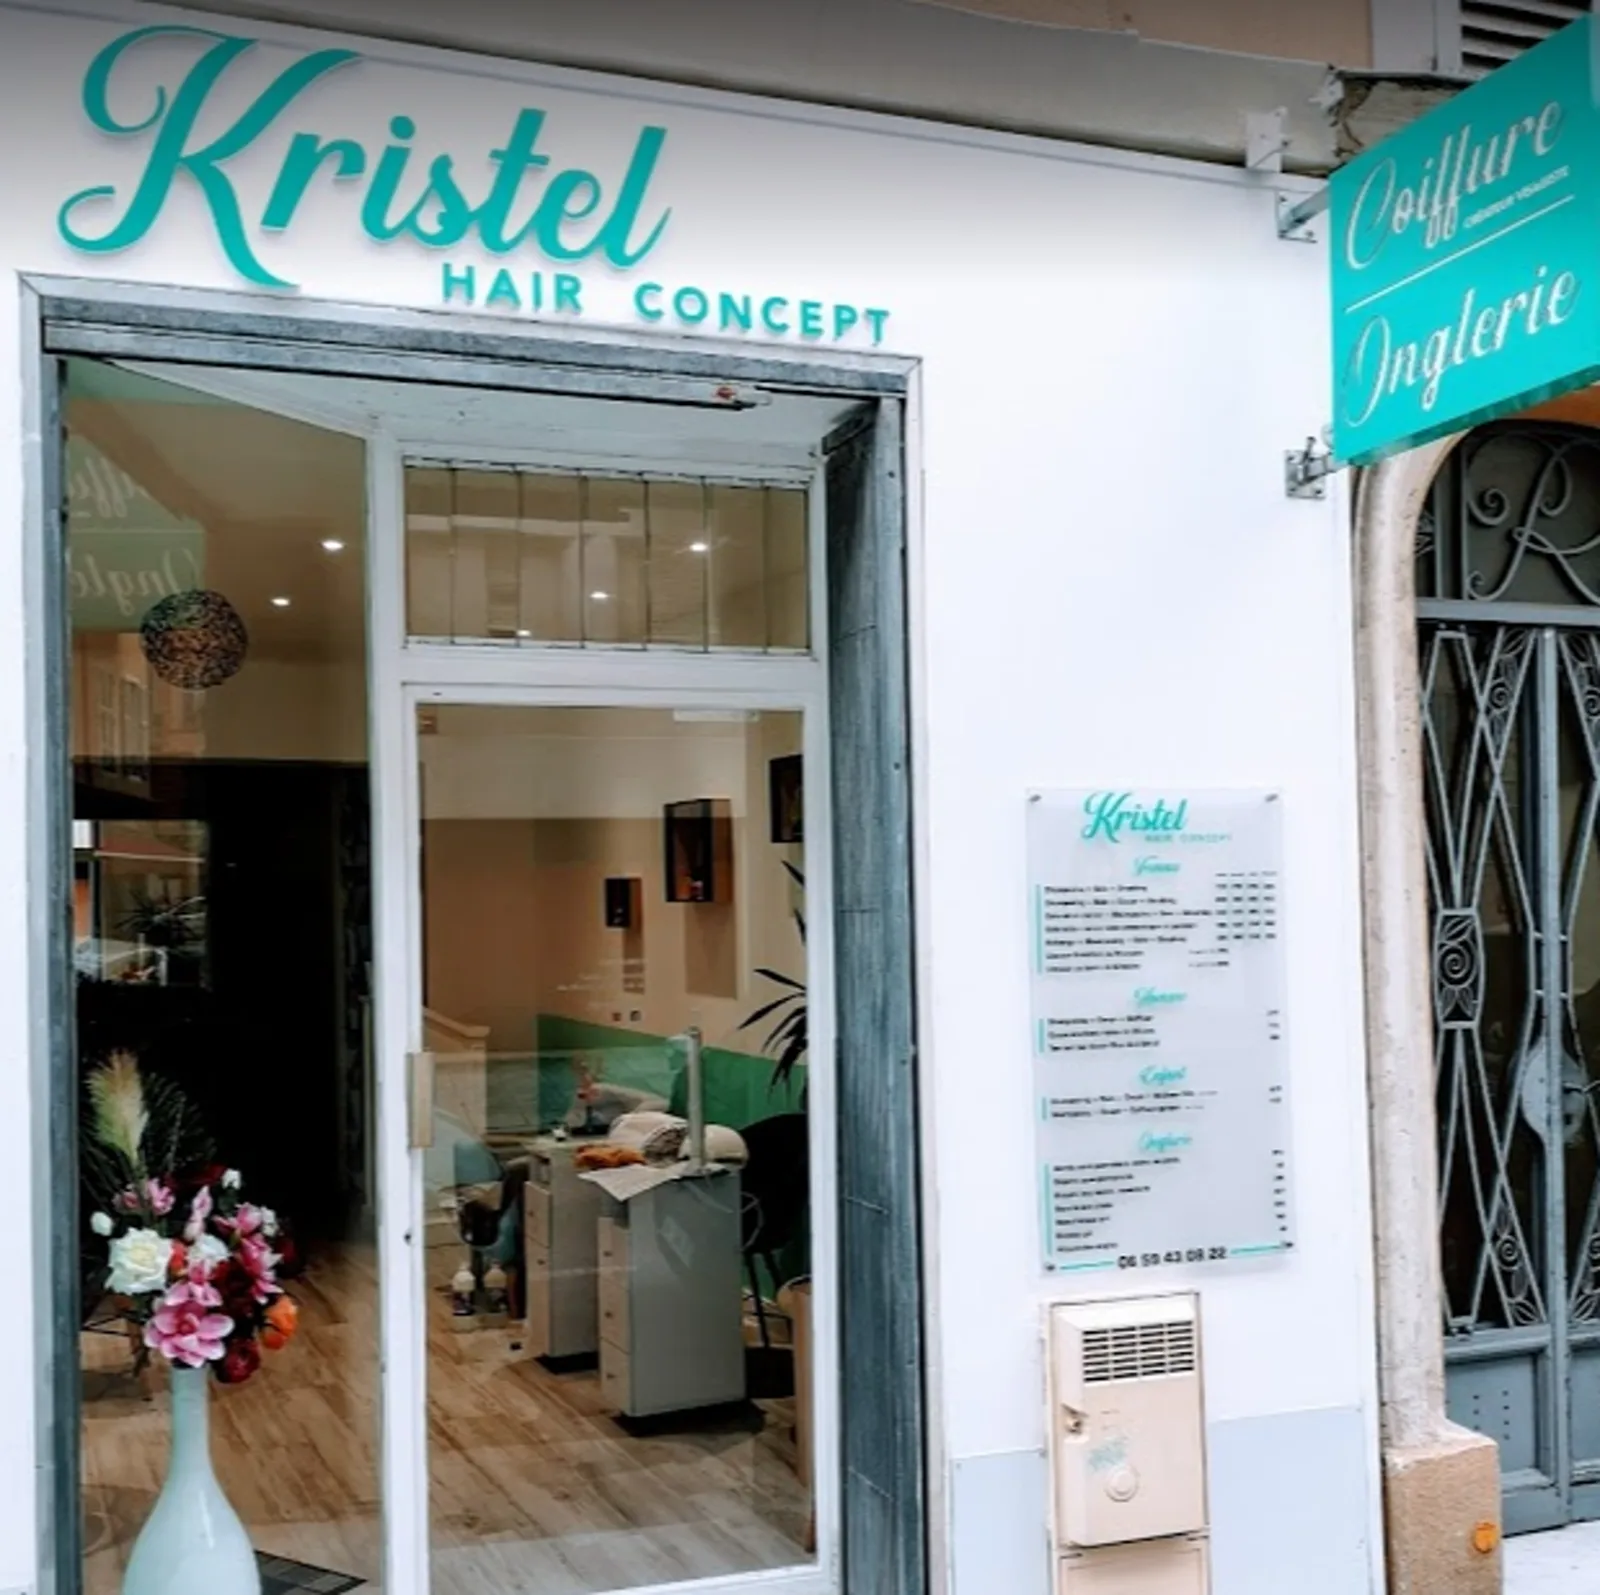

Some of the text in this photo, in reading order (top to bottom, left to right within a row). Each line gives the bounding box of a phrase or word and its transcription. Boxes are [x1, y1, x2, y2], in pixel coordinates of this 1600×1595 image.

[58, 25, 673, 289] Kristel
[1345, 101, 1563, 270] Coiffure
[441, 262, 891, 347] HAIR CONCEPT
[1081, 792, 1189, 844] Kristel
